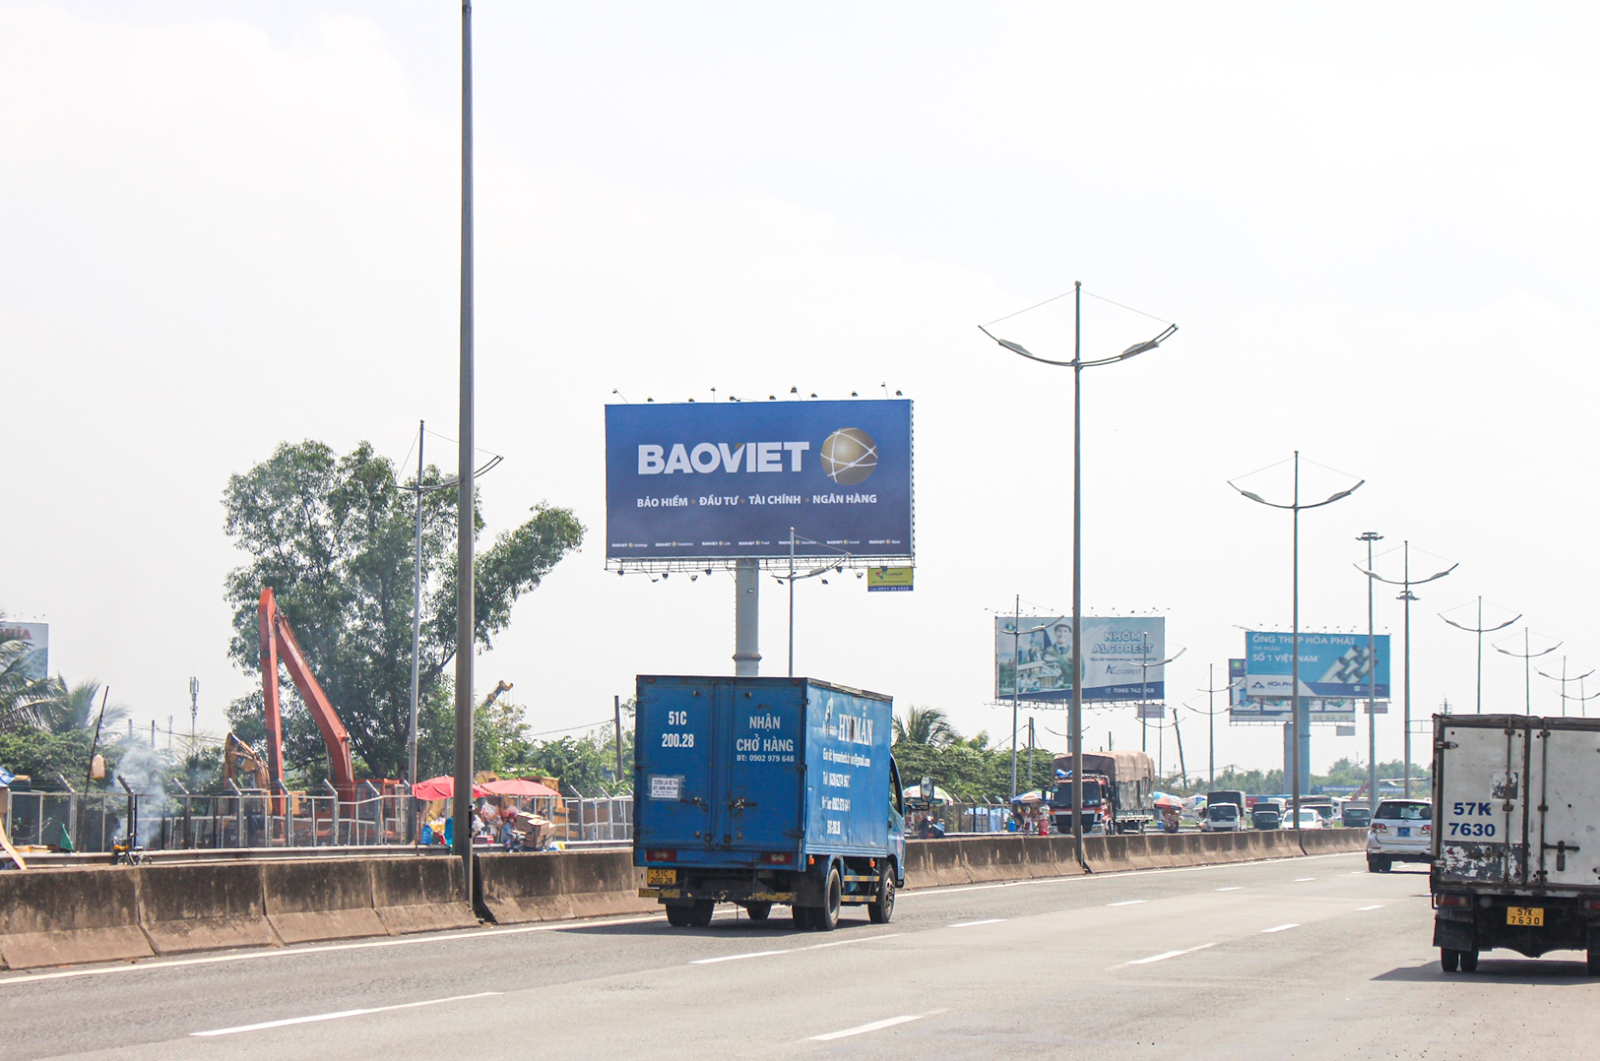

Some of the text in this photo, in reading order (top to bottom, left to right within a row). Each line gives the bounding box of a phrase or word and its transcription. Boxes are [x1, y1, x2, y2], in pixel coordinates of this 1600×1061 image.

[638, 442, 810, 475] BAOVIET
[637, 496, 659, 508] BẢO
[661, 494, 688, 507] HIỂM
[724, 495, 739, 506] TƯ
[749, 494, 765, 506] TÀI
[767, 493, 801, 505] CHÍNH
[812, 493, 846, 505] NGÂN
[847, 492, 877, 504] HÀNG
[1104, 629, 1141, 642] NHÔM
[1252, 632, 1356, 645] ỐNG THP HÒA PHÁT
[1092, 644, 1154, 654] ALCOREST
[1252, 652, 1266, 662] SỐ
[668, 710, 687, 726] 51C
[749, 713, 781, 732] NHẬN
[661, 733, 695, 748] 200.28
[736, 734, 794, 752] CHỞ HÀNG
[749, 754, 766, 762] 0902
[767, 755, 780, 763] 979
[781, 755, 795, 763] 648
[1453, 802, 1493, 816] 57K
[1449, 822, 1496, 837] 7630
[1517, 907, 1533, 917] 57K
[1510, 916, 1540, 925] 7630
